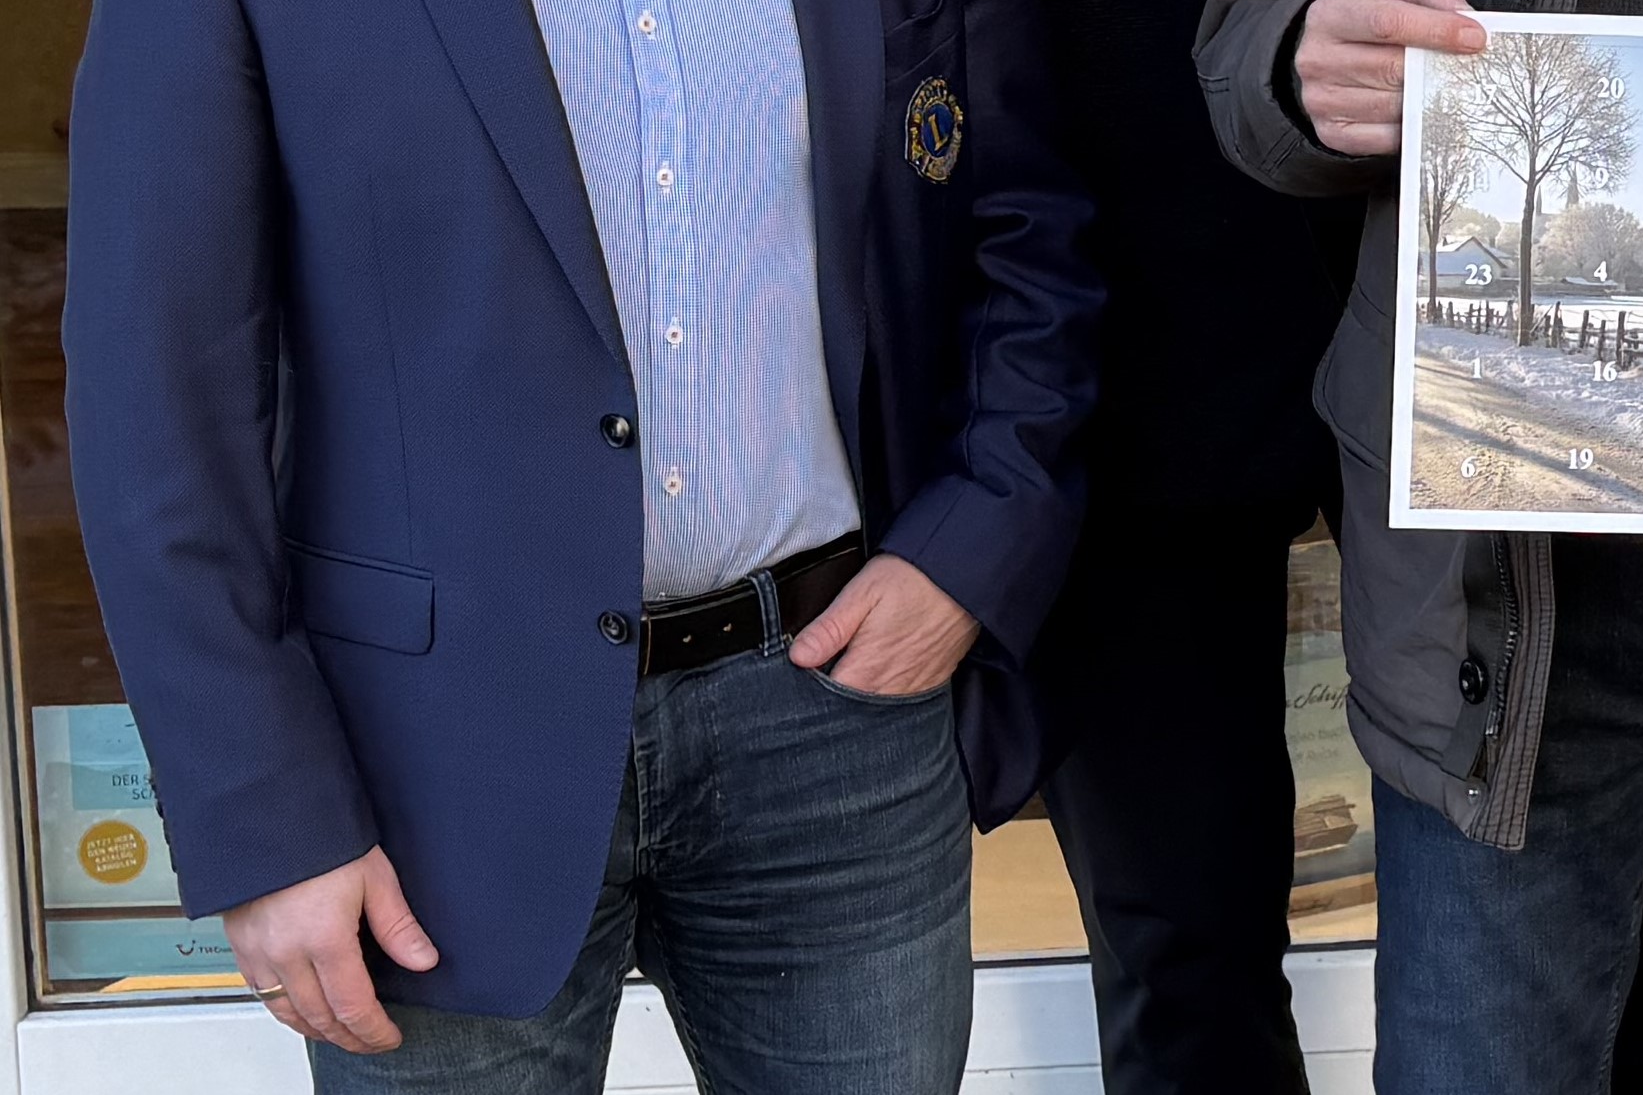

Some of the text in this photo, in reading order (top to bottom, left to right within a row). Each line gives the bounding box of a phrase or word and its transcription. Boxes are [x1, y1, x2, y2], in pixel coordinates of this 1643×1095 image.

[1472, 81, 1498, 105] 17
[1597, 76, 1626, 100] 20
[1593, 167, 1610, 189] 9
[1464, 263, 1493, 286] 23
[1593, 260, 1608, 283] 4
[1472, 357, 1482, 380] 1
[1591, 360, 1618, 383] 16
[1460, 456, 1477, 478] 6
[1568, 447, 1594, 470] 19
[112, 773, 140, 787] DER
